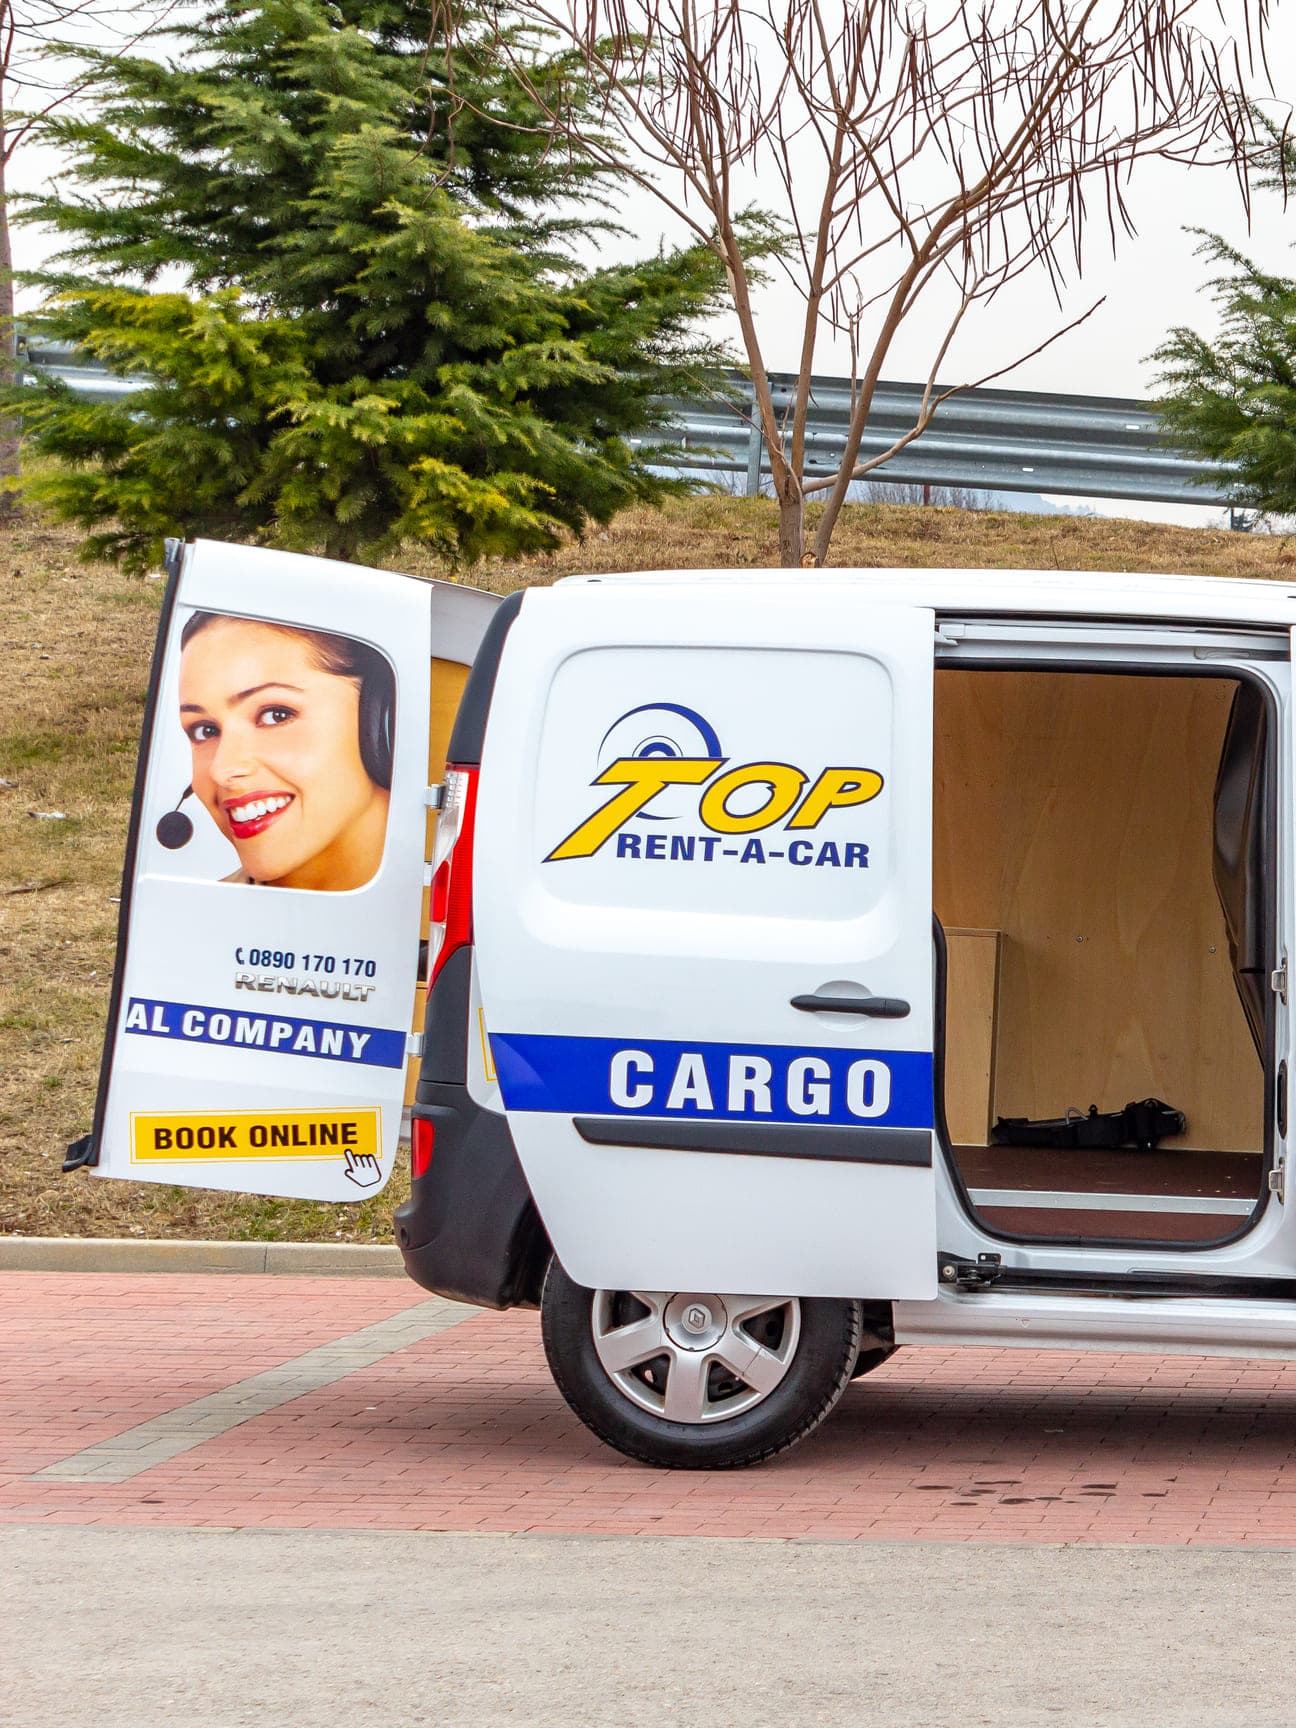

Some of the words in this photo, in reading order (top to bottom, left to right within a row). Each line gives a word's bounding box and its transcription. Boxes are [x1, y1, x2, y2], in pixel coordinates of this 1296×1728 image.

[542, 757, 885, 863] TOP
[616, 833, 870, 868] RENT-A-CAR
[249, 948, 295, 969] 0890
[302, 954, 335, 973] 170
[342, 958, 376, 978] 170
[235, 971, 376, 1002] RENAULT
[126, 1003, 170, 1033] AL
[182, 1010, 371, 1059] COMPANY
[608, 1049, 892, 1118] CARGO
[154, 1127, 237, 1150] BOOK
[250, 1122, 358, 1147] ONLINE
